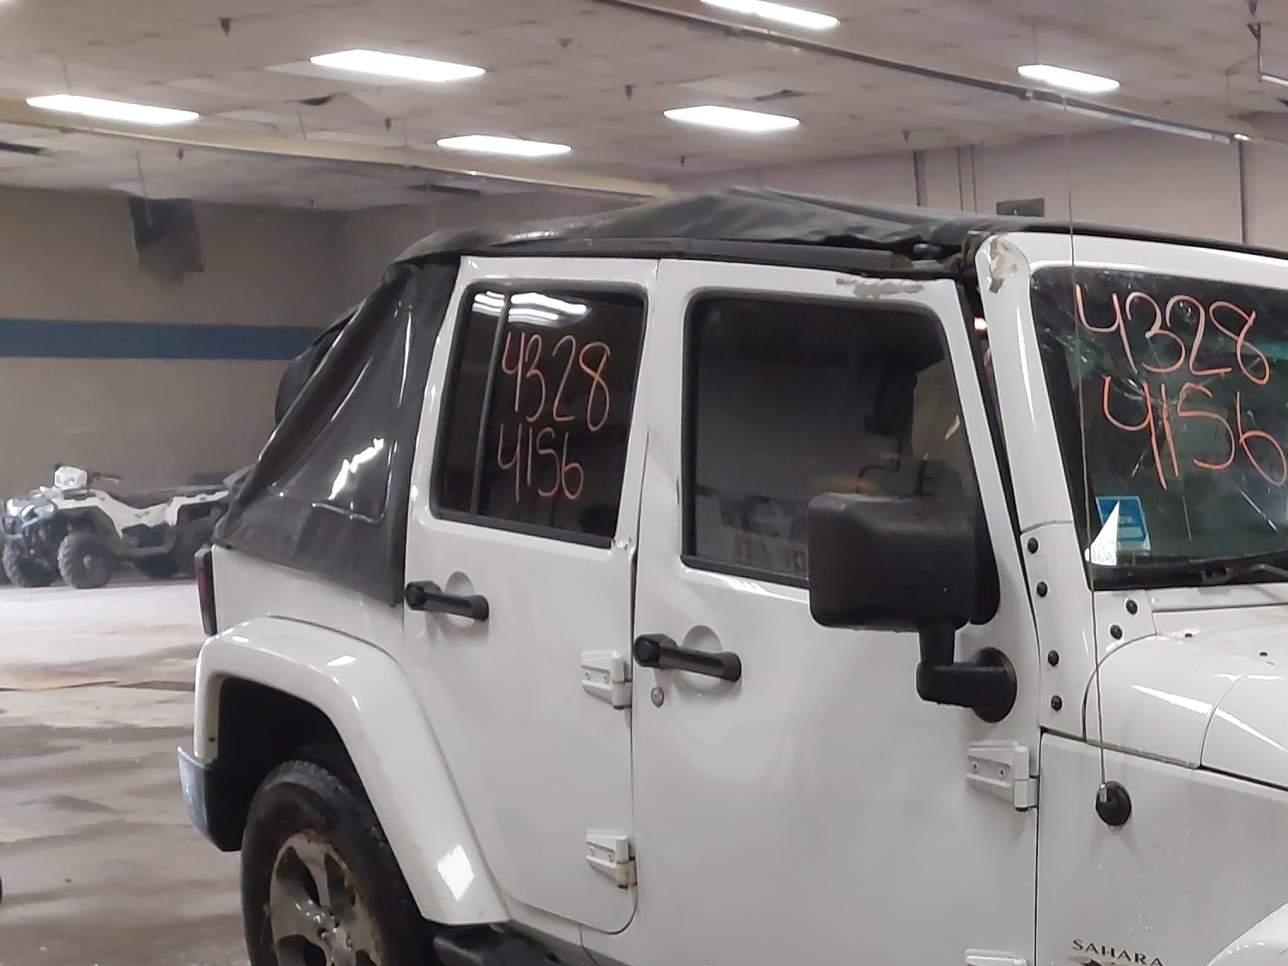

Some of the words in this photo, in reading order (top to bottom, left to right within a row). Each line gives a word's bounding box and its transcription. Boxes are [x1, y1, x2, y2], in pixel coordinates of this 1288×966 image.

[501, 331, 611, 432] 4328
[1075, 284, 1270, 385] 4328
[497, 423, 584, 503] 4156
[1102, 374, 1288, 490] 4156
